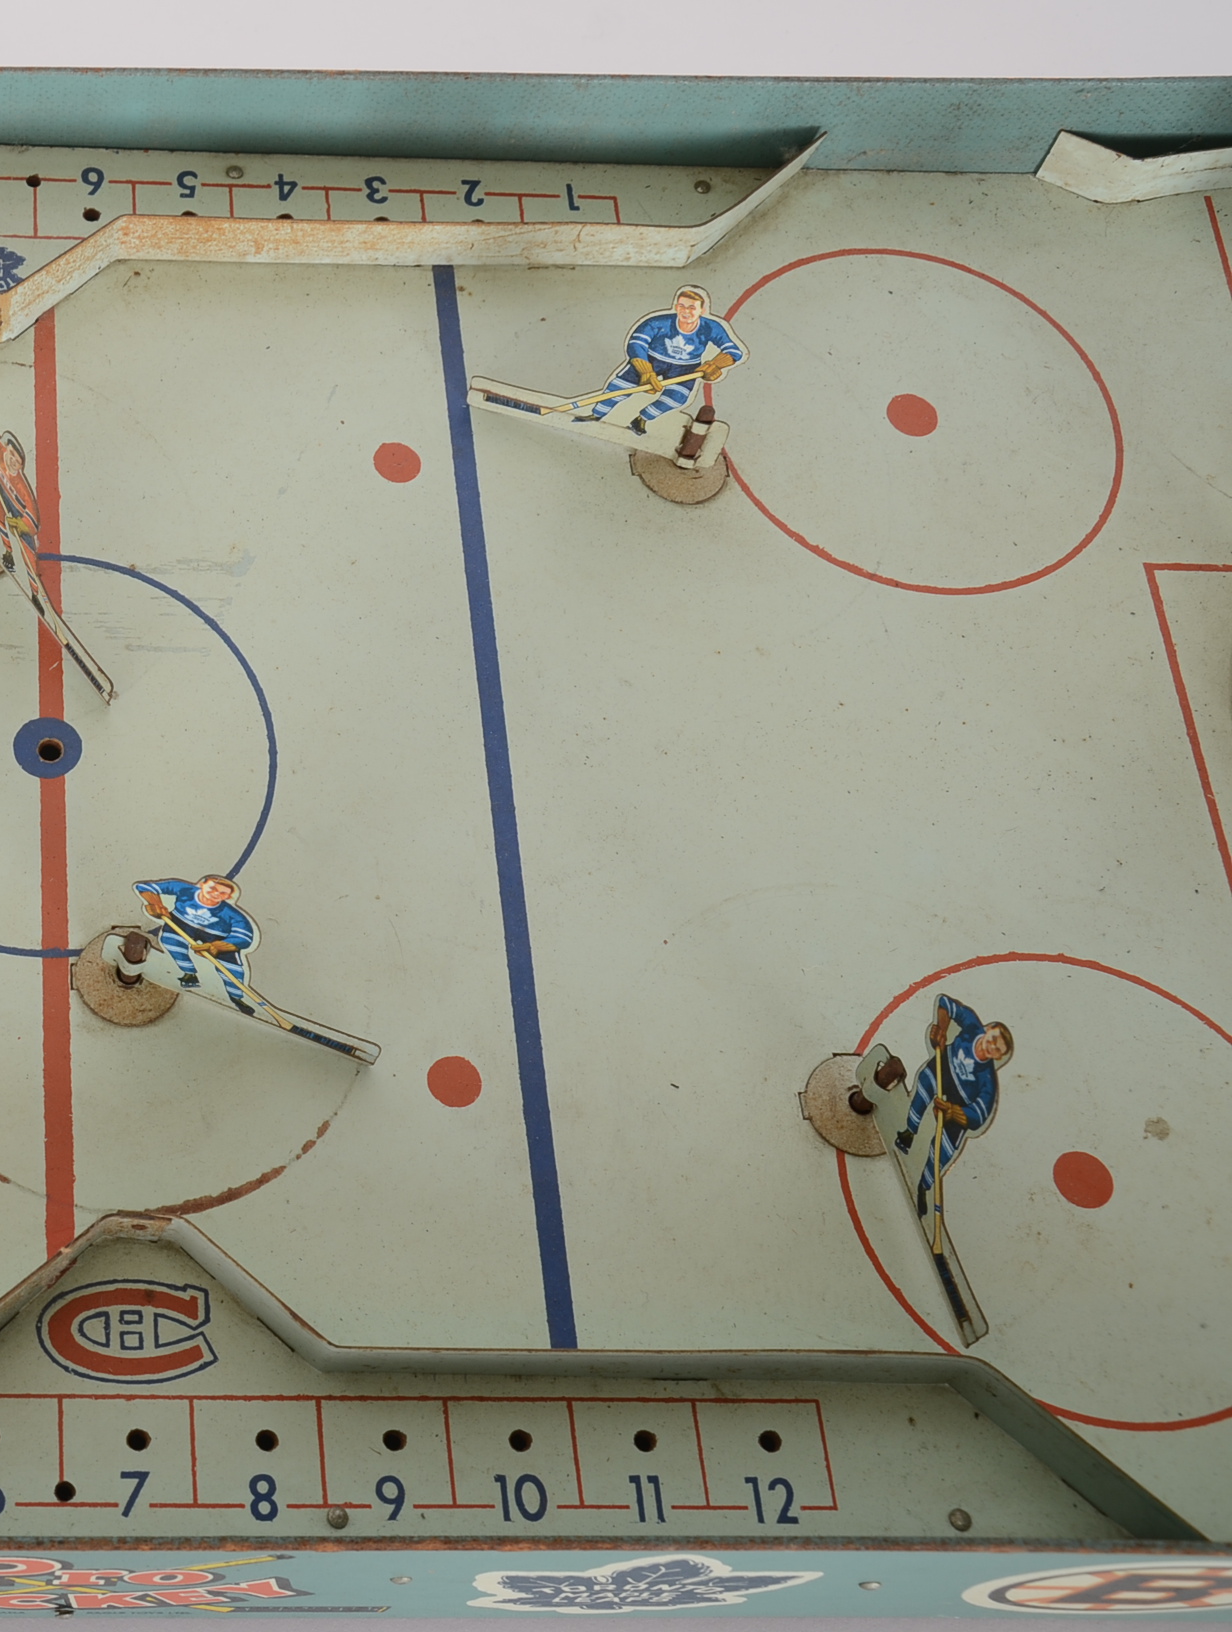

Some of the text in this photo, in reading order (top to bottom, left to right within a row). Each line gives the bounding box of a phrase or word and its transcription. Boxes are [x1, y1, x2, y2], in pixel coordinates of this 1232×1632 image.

[80, 168, 105, 196] 6
[176, 171, 198, 199] 5
[274, 174, 298, 201] 4
[365, 176, 388, 204] 3
[461, 179, 485, 207] 2
[565, 184, 580, 211] 1
[119, 1471, 150, 1518] 7
[248, 1473, 278, 1522] 8
[374, 1475, 405, 1521] 9
[495, 1474, 548, 1522] 10
[628, 1475, 665, 1523] 11
[744, 1477, 799, 1524] 12
[531, 1584, 726, 1594] TORONTO
